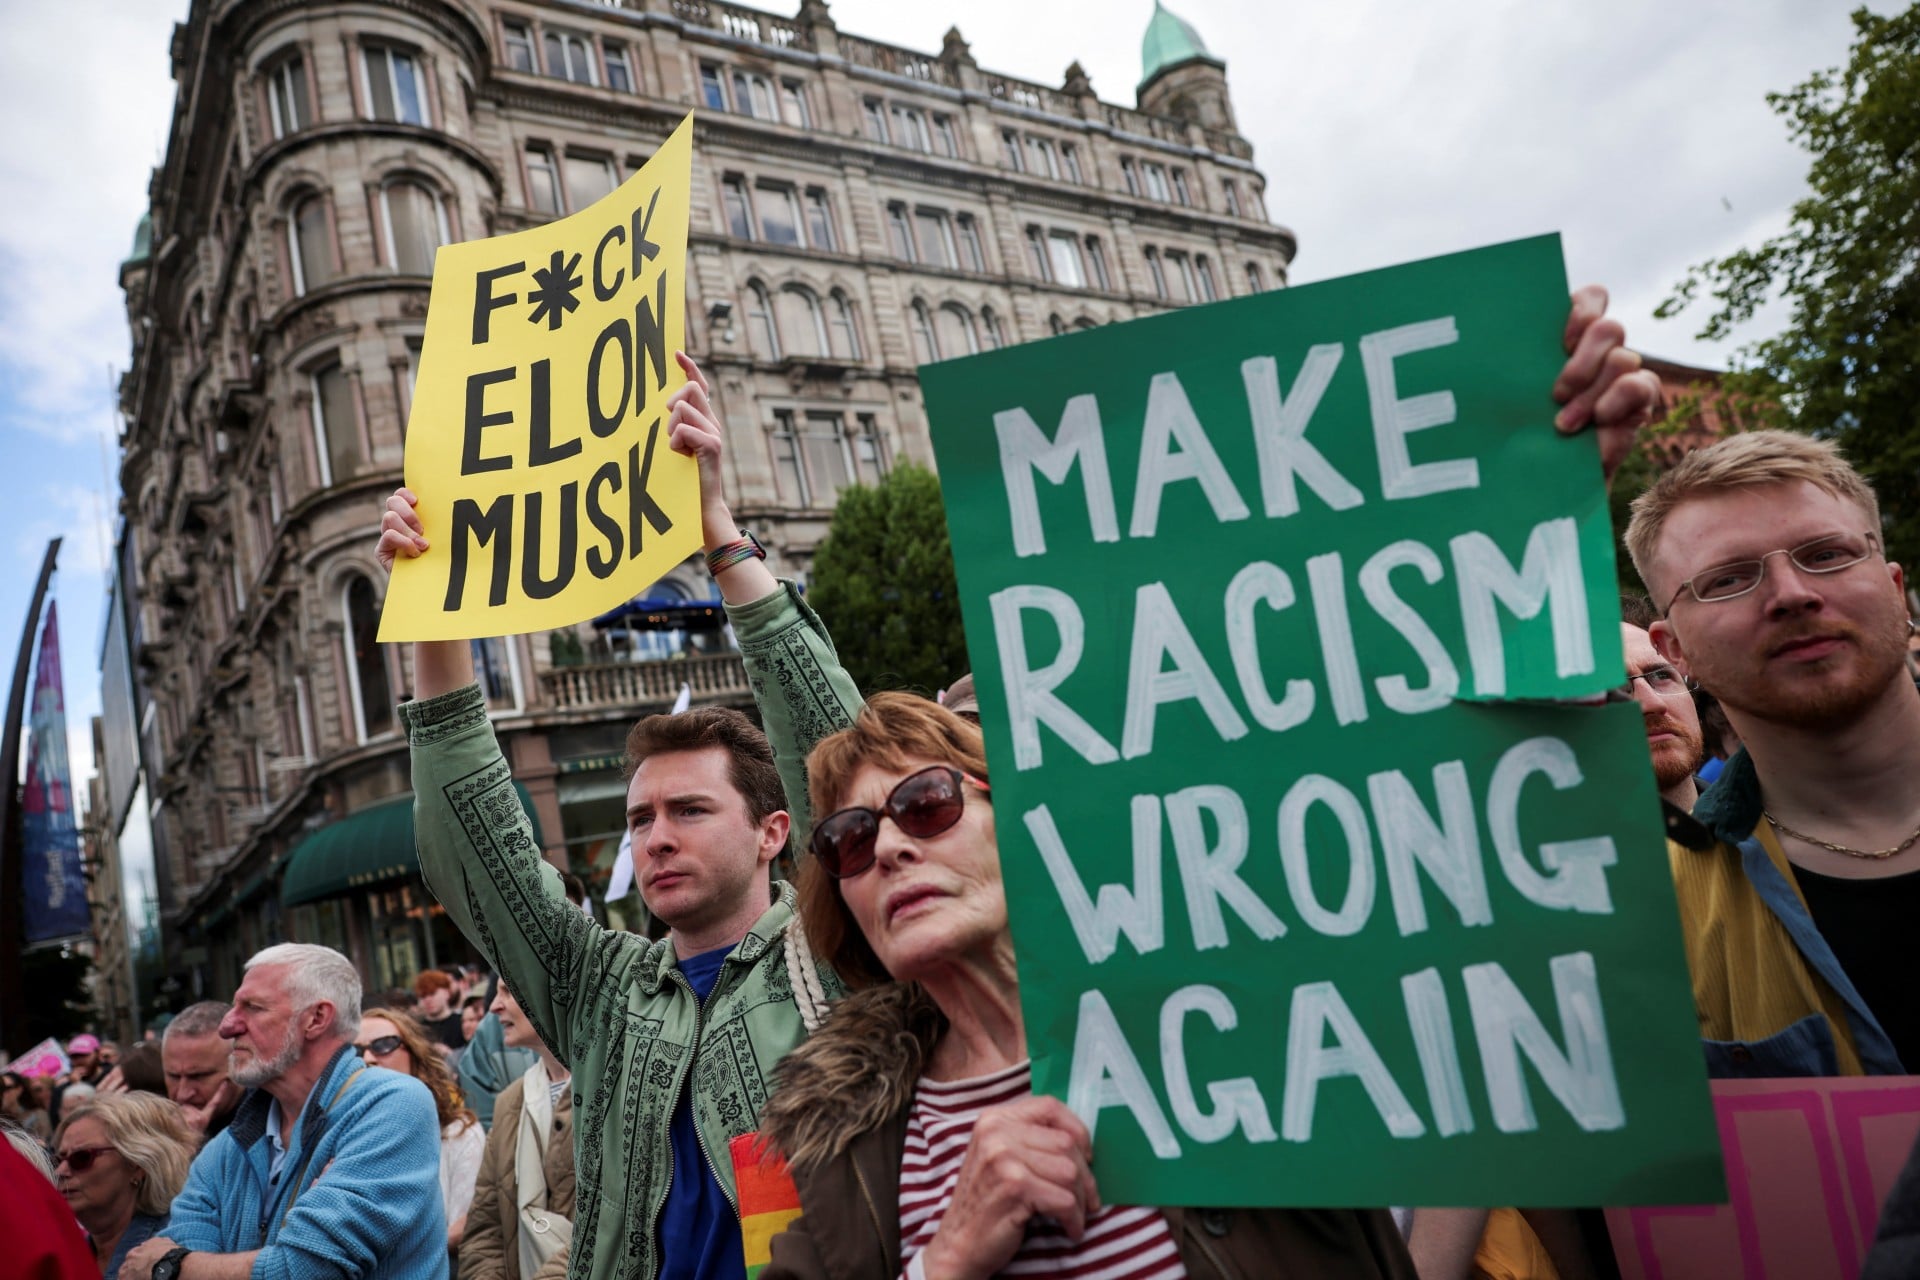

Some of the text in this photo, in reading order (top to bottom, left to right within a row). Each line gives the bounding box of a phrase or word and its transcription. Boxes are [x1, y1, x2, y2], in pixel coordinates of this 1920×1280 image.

[461, 269, 667, 476] ELON
[993, 315, 1480, 557] MAKE
[443, 417, 674, 612] MUSK
[989, 516, 1595, 771] RACISM
[1023, 737, 1618, 964] WRONG
[1067, 951, 1626, 1160] AGAIN
